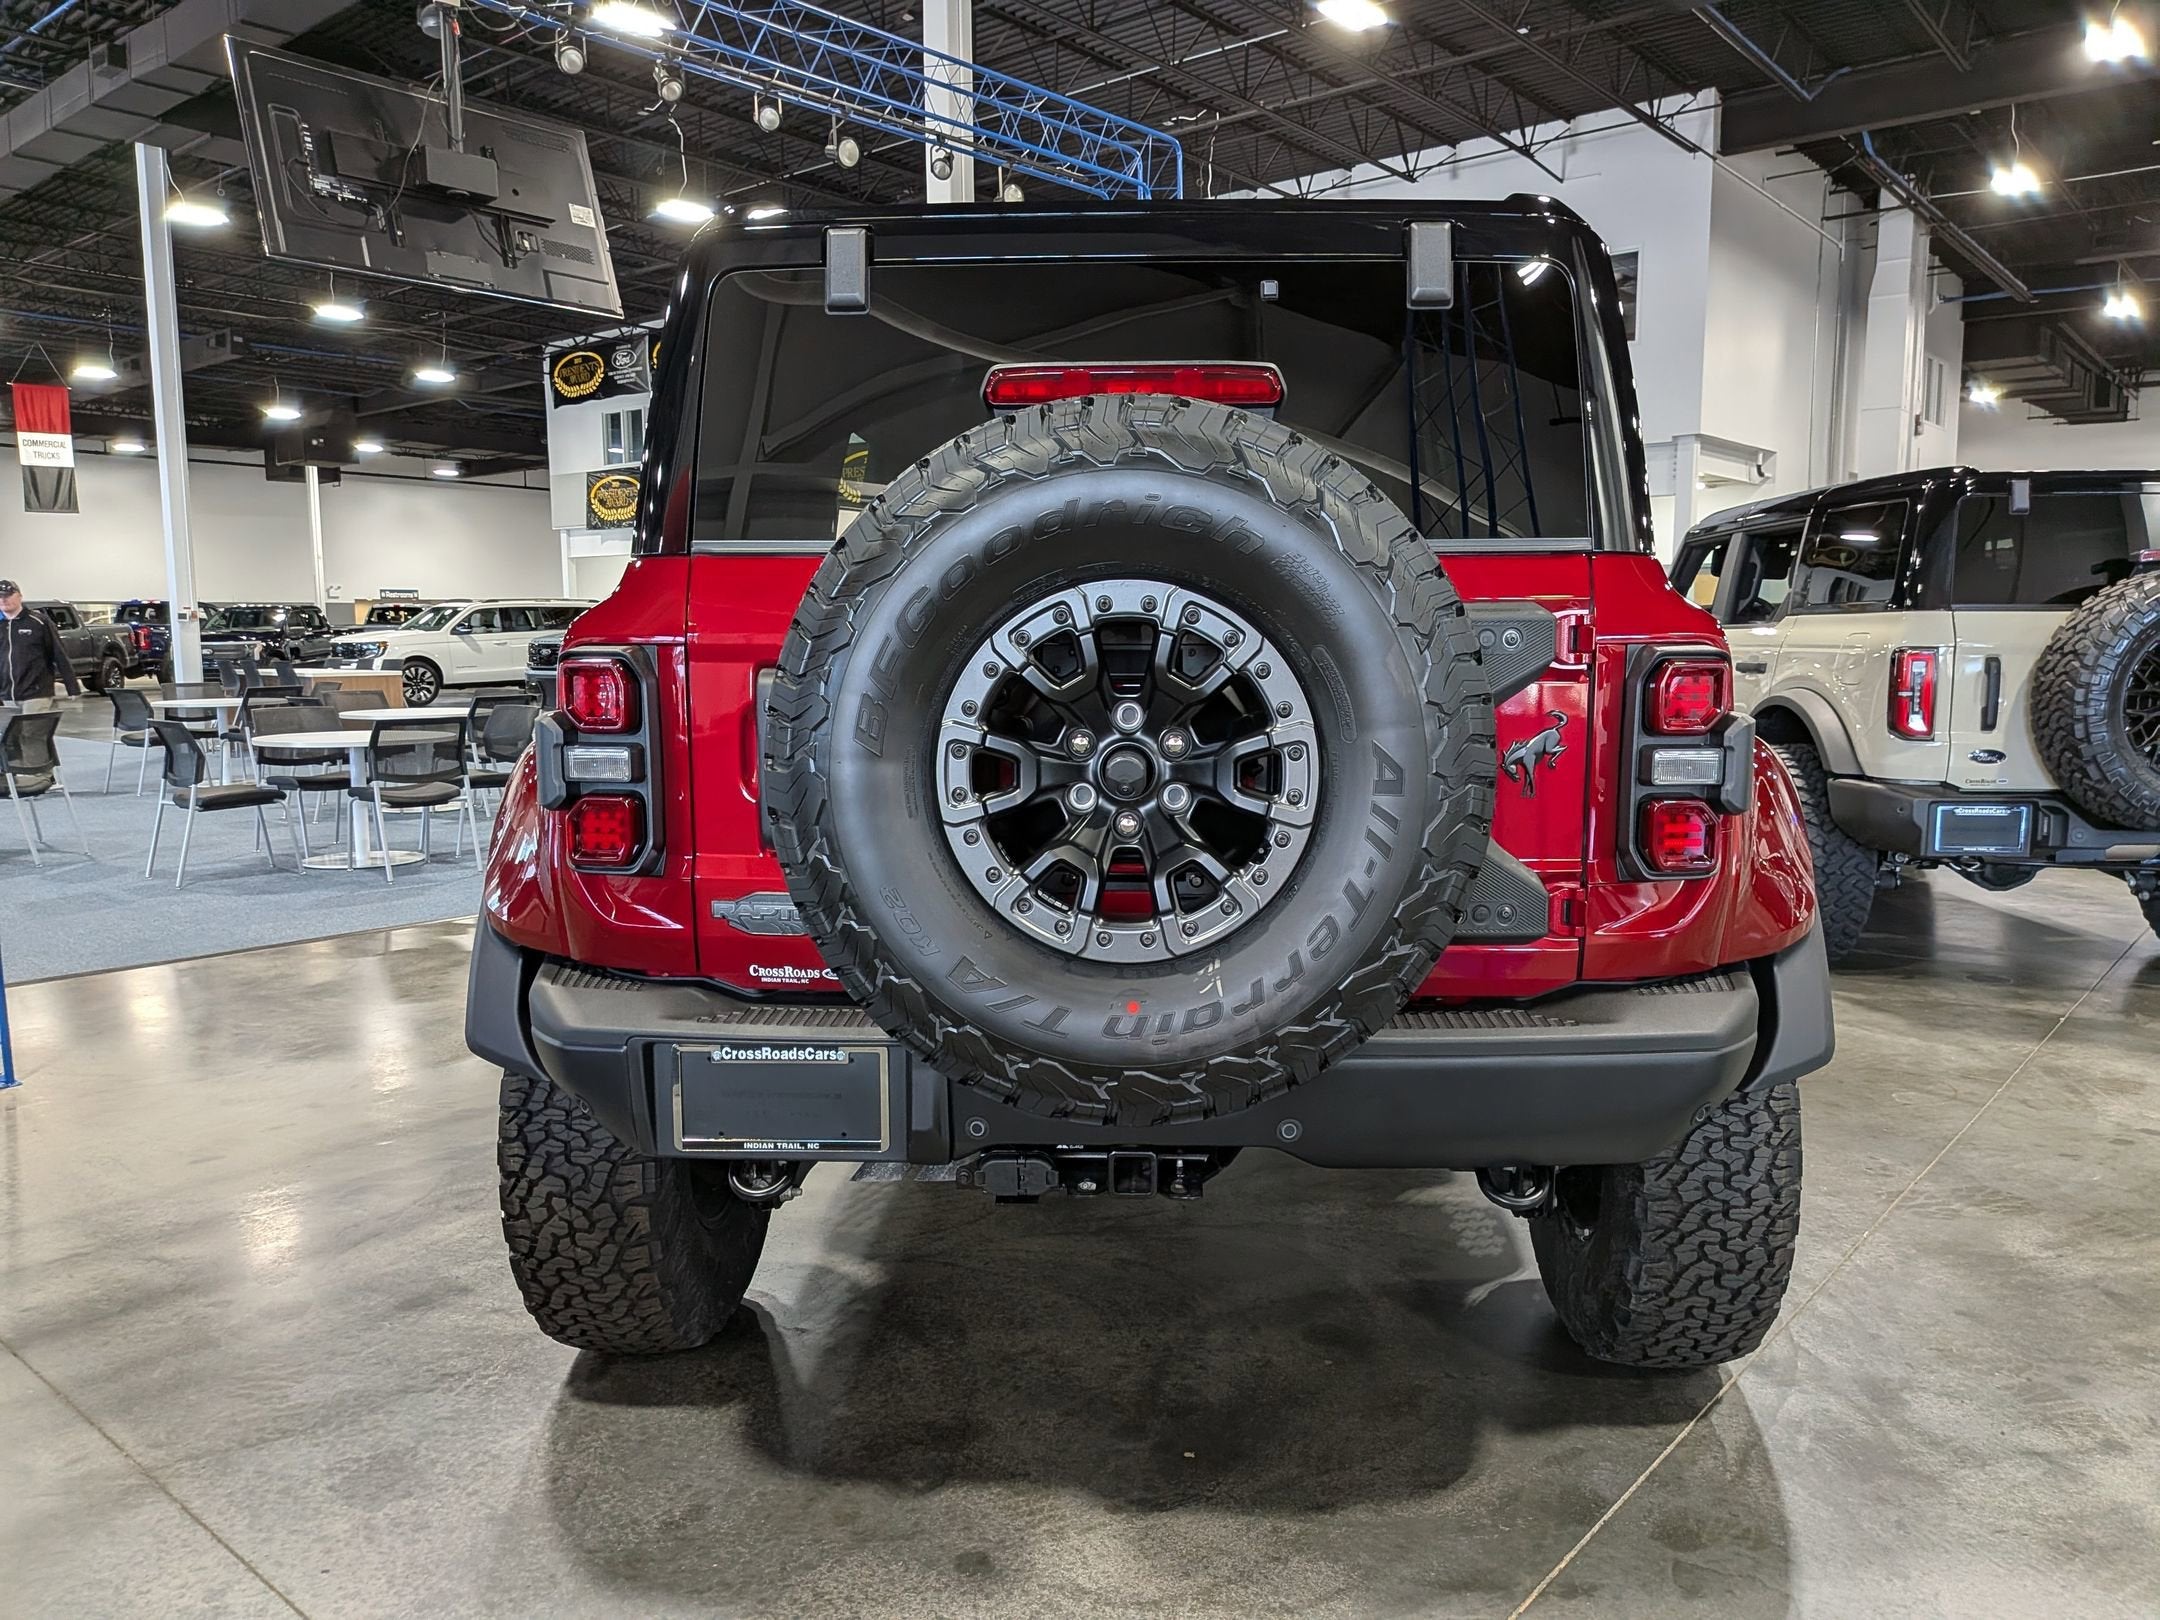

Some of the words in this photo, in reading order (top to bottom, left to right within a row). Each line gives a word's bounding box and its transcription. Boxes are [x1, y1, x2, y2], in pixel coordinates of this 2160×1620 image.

[22, 439, 67, 449] COMMERCIAL
[33, 451, 61, 459] TRUCKS
[853, 494, 1266, 757] BFGoodrich
[1101, 740, 1406, 1044] All-Terrain
[946, 954, 1072, 1038] T/A
[721, 1047, 837, 1060] CrossRoadsCars
